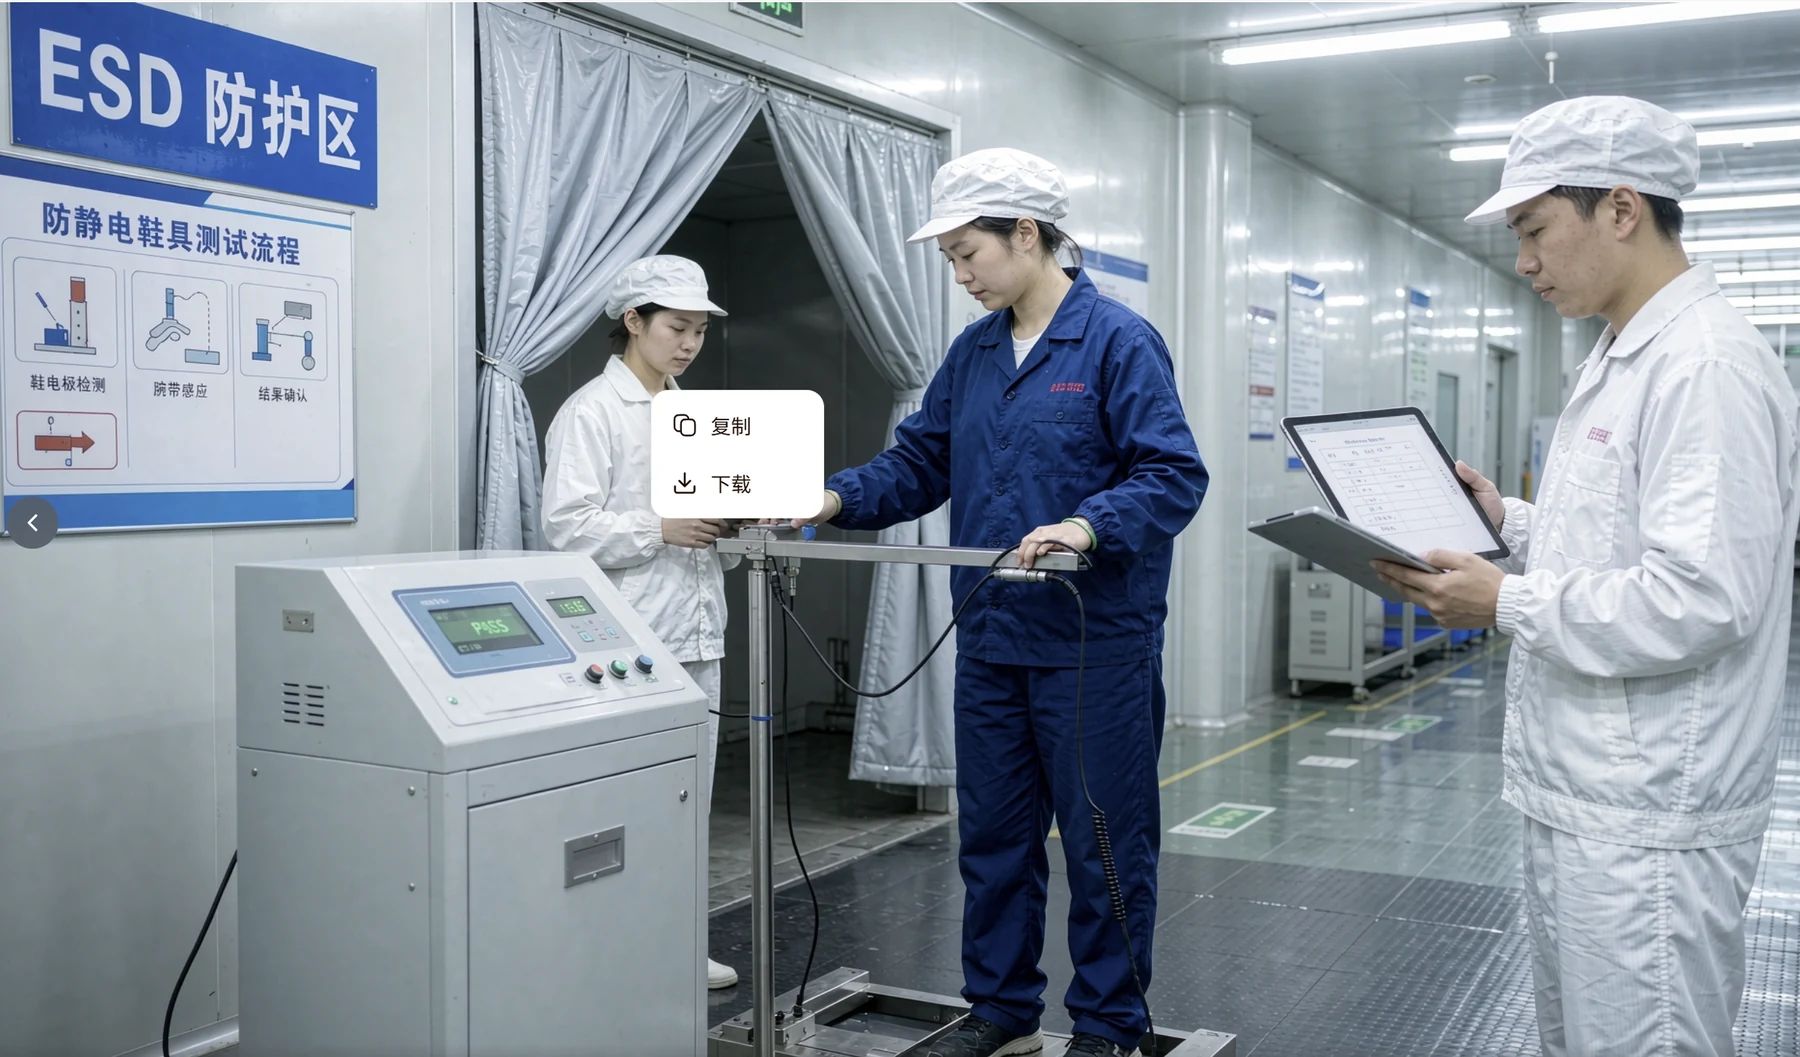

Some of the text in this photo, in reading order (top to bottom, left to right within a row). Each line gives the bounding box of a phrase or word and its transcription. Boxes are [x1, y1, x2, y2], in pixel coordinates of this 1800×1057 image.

[39, 28, 361, 171] ESD 防护区
[42, 201, 301, 266] 防静电鞋具测试流程
[30, 374, 106, 394] 鞋电极检测
[153, 380, 208, 399] 腕带感应
[258, 386, 308, 403] 结果确认
[470, 619, 510, 636] PASS
